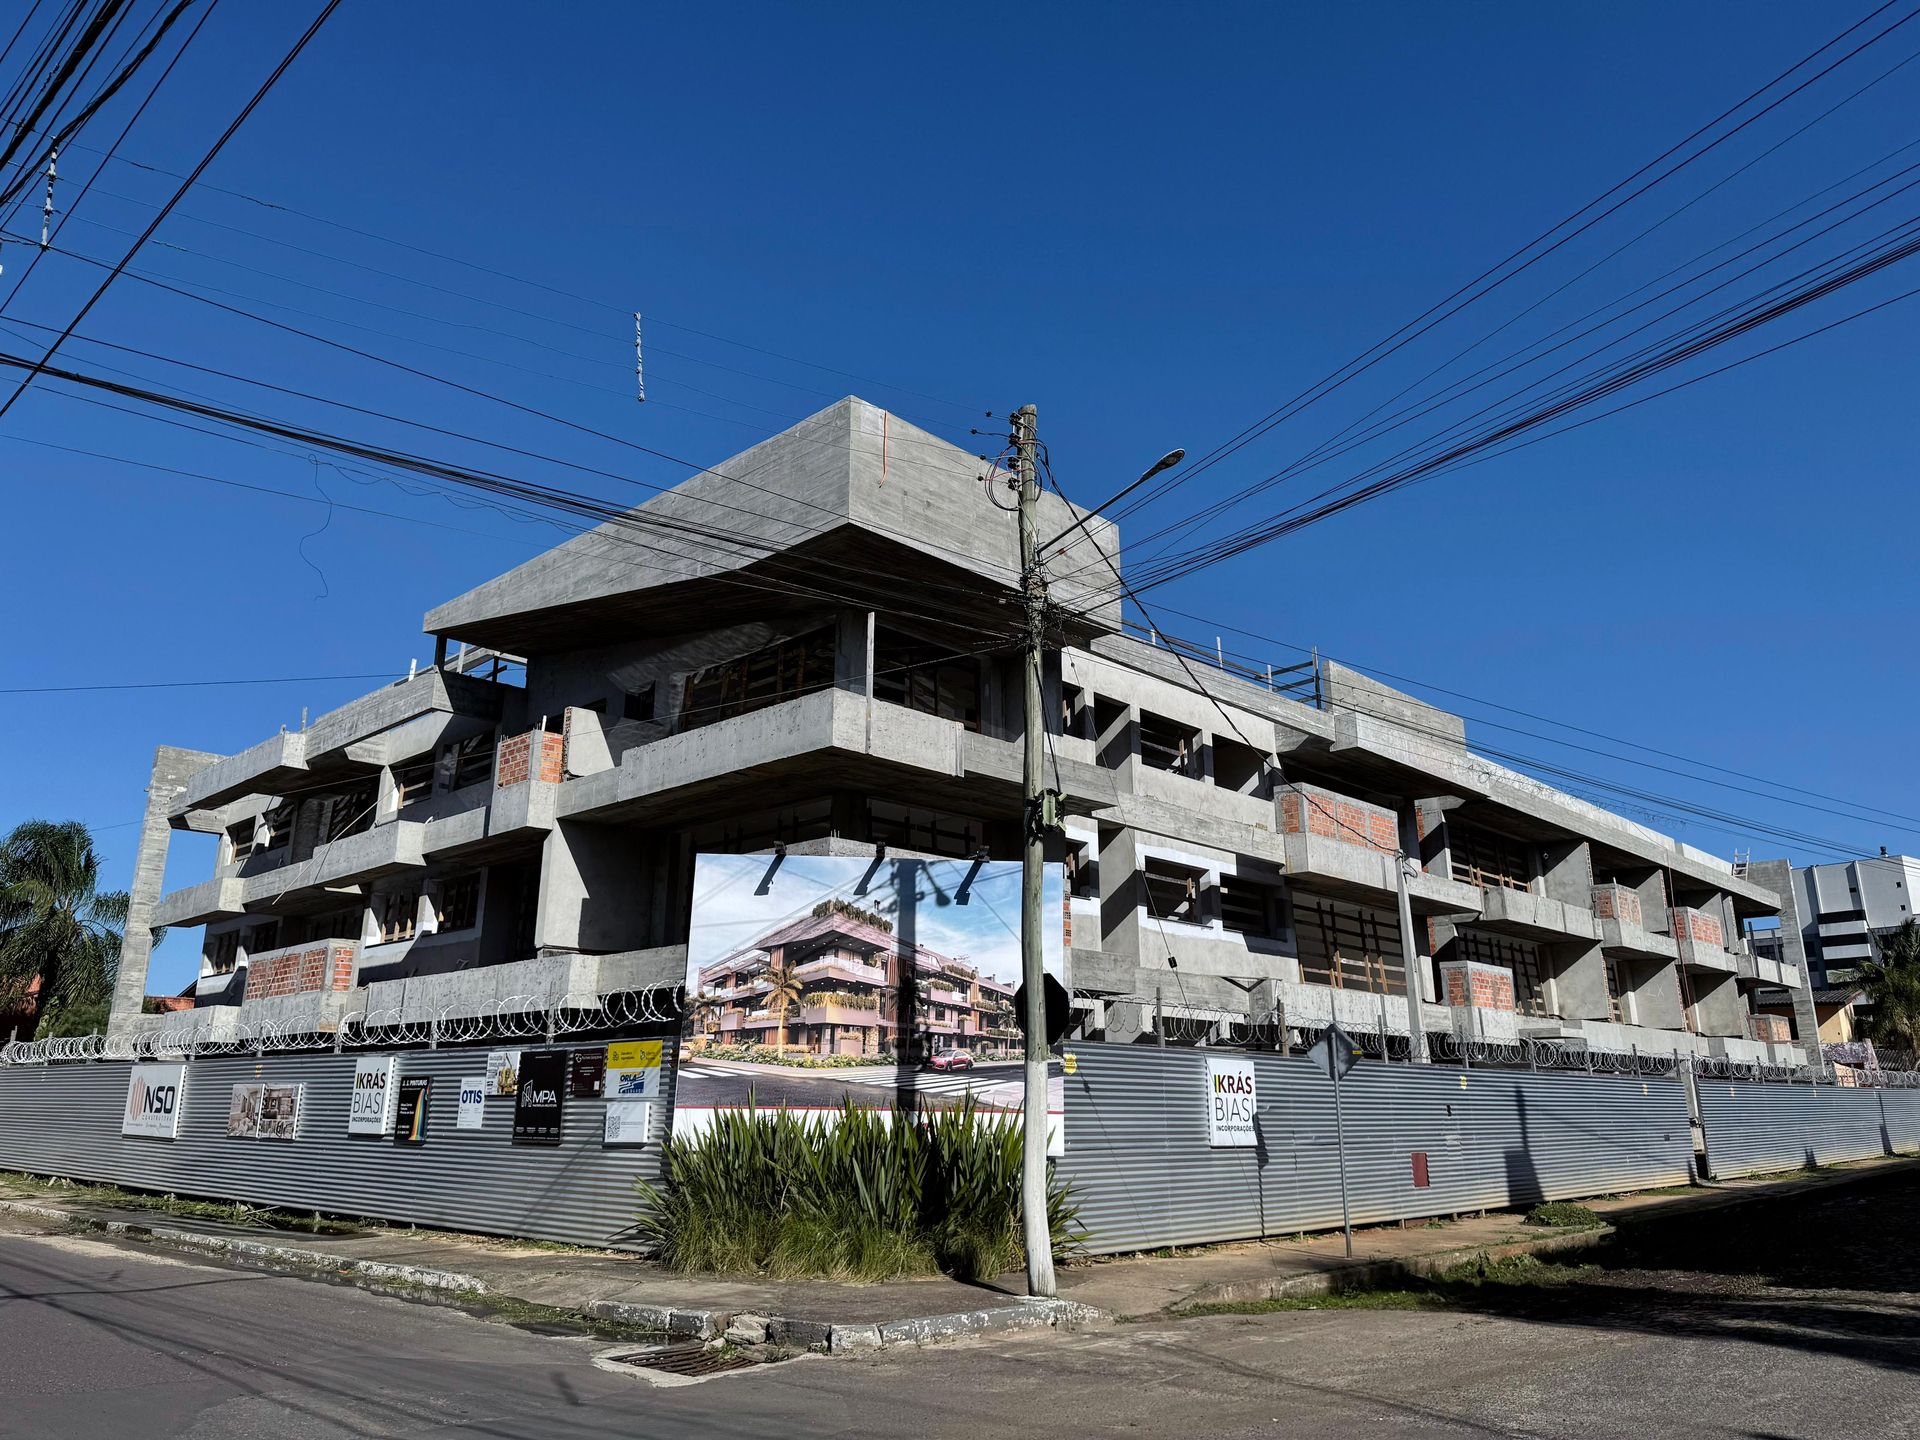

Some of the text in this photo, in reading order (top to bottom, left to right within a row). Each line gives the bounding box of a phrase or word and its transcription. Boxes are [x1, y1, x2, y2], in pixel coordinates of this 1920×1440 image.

[356, 1068, 386, 1089] IKRÁS
[1214, 1071, 1252, 1094] IKRÁS
[143, 1086, 175, 1113] NSO
[352, 1092, 384, 1114] BIASI
[461, 1090, 482, 1103] OTIS
[532, 1090, 557, 1103] MPA
[1215, 1097, 1254, 1121] BIASI
[1216, 1124, 1255, 1133] INCORPORAÇÕES
